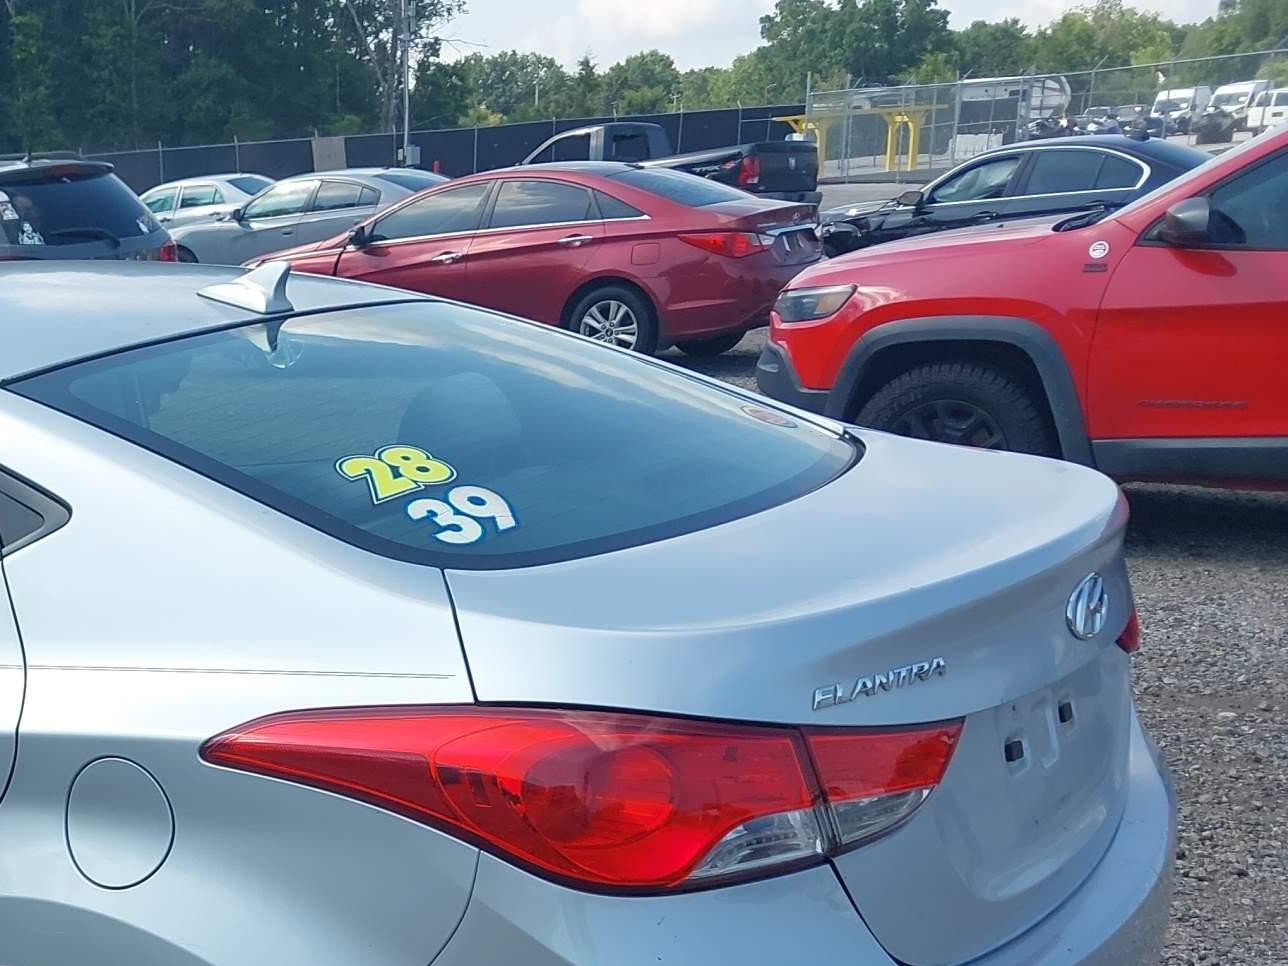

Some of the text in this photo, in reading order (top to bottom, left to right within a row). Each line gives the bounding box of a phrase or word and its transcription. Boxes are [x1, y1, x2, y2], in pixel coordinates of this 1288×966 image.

[336, 445, 456, 504] 28
[408, 486, 515, 544] 39
[812, 656, 946, 711] ELANTRA
